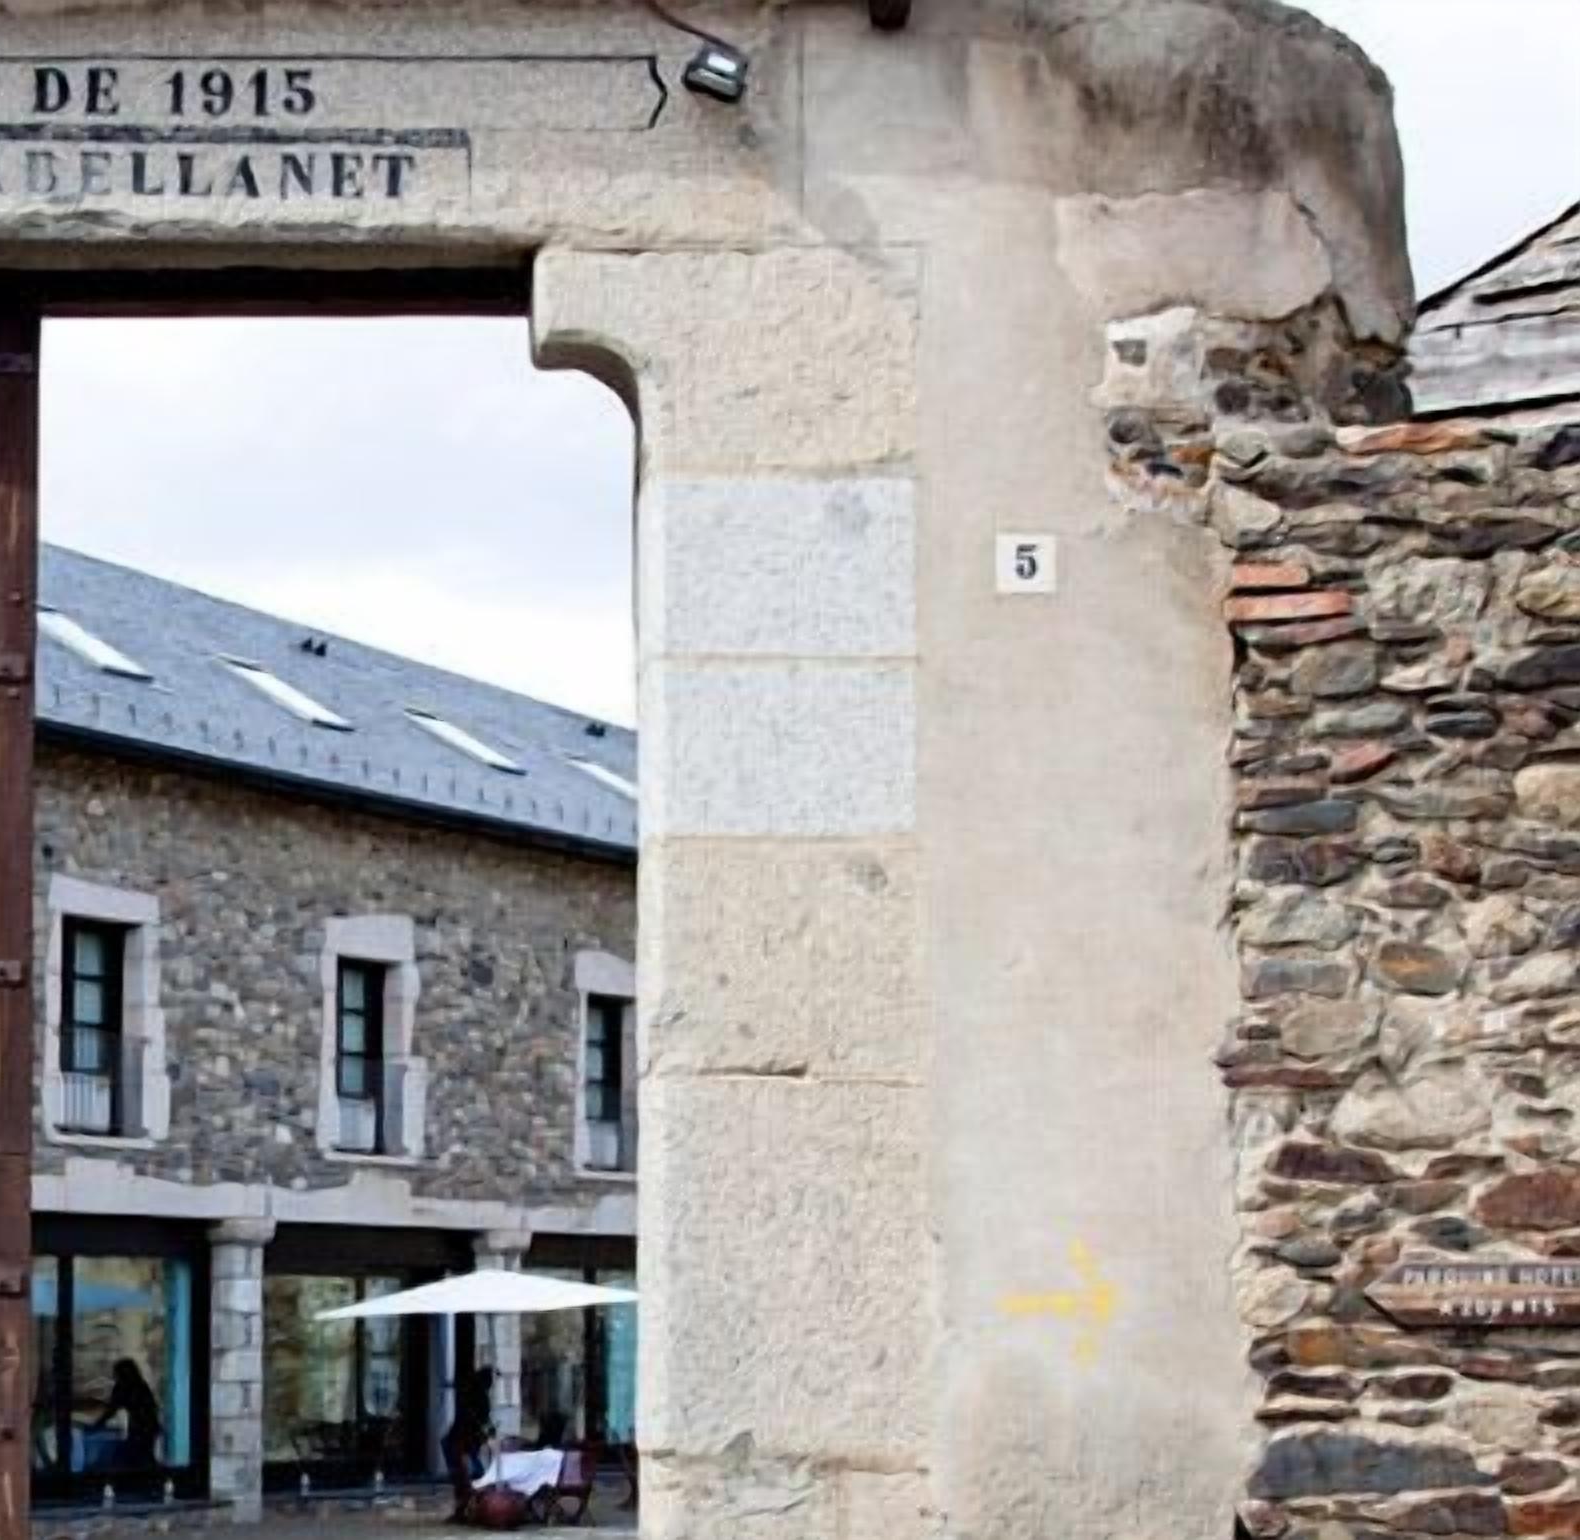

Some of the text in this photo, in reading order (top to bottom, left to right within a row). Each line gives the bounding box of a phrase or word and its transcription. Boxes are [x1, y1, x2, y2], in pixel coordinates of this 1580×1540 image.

[32, 66, 120, 116] DE
[164, 66, 318, 117] 1915
[1015, 543, 1038, 580] 5
